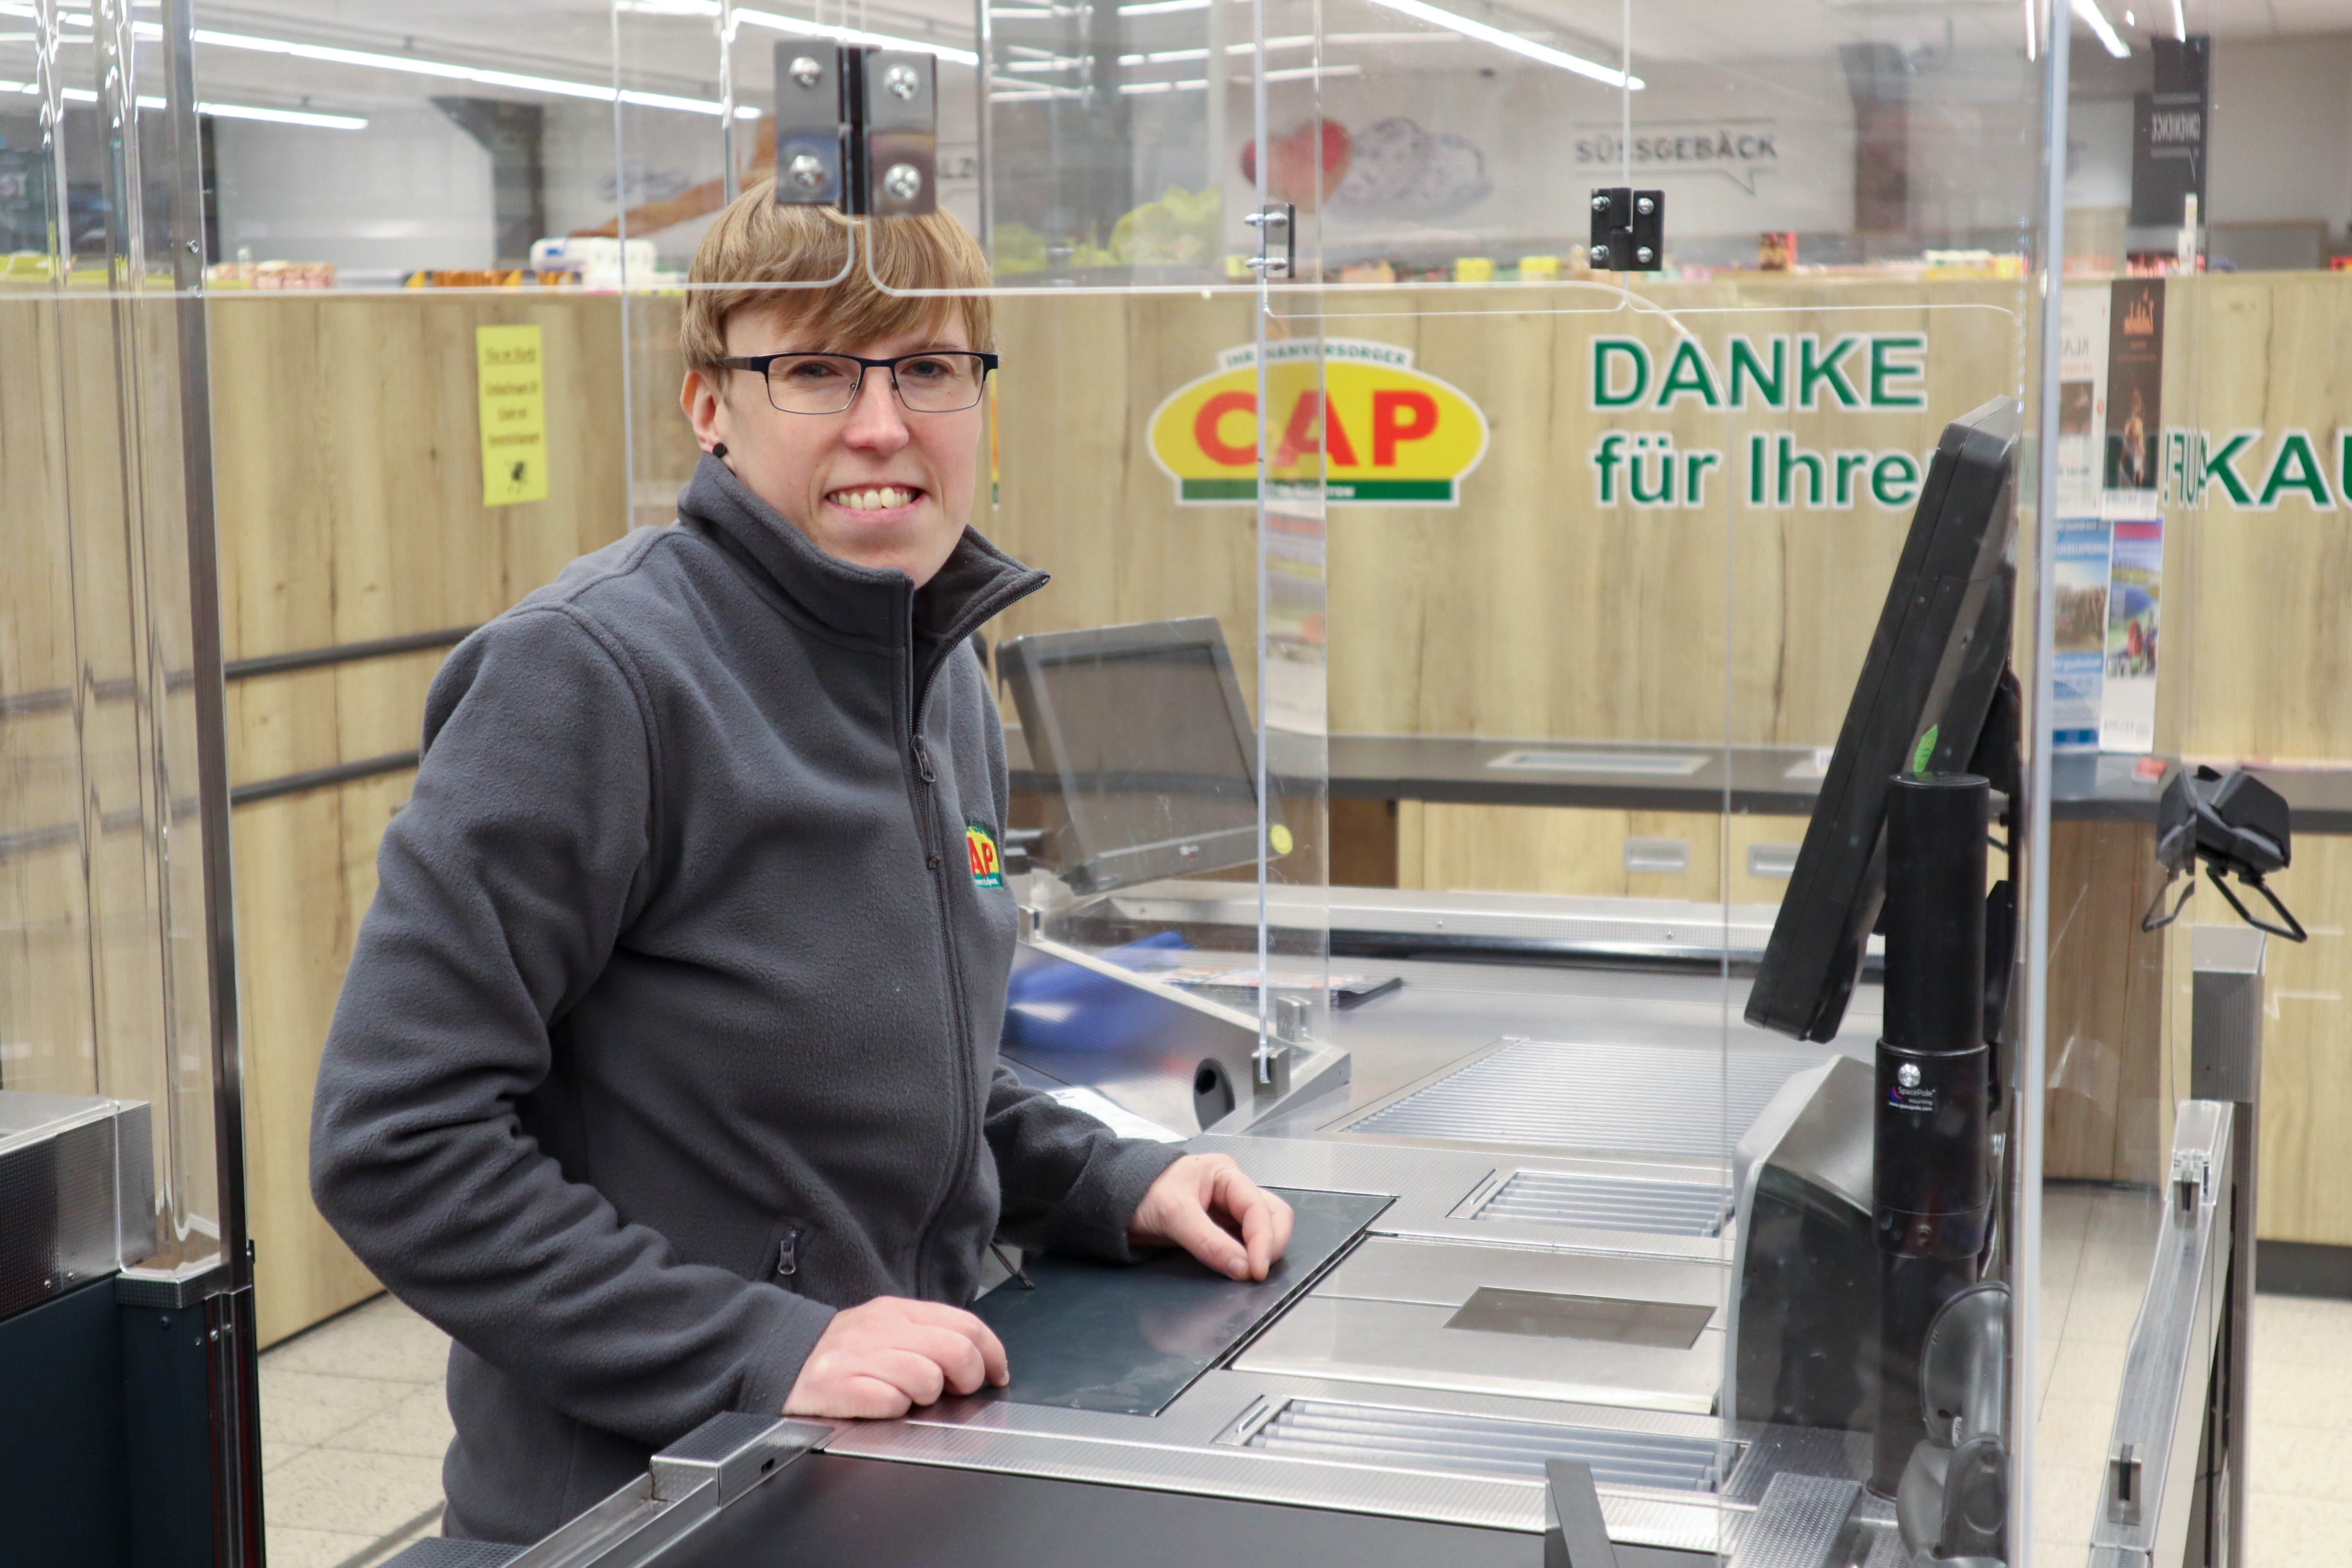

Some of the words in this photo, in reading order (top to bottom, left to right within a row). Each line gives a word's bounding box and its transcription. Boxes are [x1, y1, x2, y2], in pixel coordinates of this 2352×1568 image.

[1594, 339, 1924, 406] DANKE
[1193, 389, 1439, 467] CAP
[1594, 436, 1719, 503] für
[1751, 436, 1938, 506] Ihre
[2207, 435, 2352, 505] KA
[967, 837, 993, 877] AP
[1898, 1086, 1933, 1097] SpacePole
